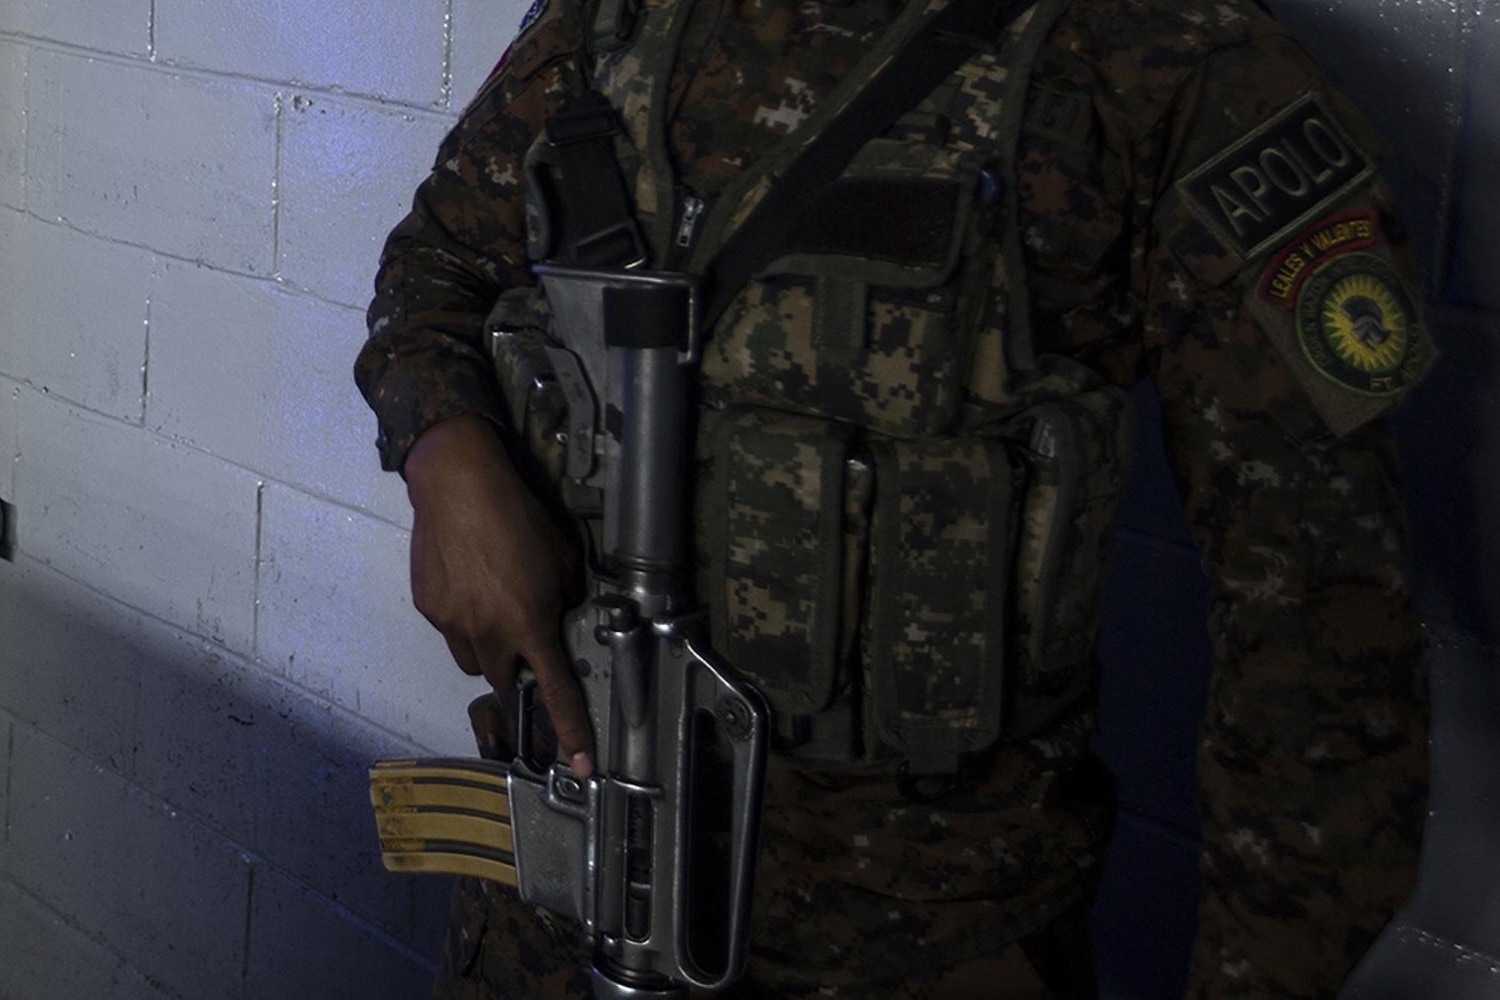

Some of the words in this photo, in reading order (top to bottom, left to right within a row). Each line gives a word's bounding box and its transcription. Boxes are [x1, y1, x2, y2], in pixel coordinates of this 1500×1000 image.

[1210, 117, 1350, 238] APOLO
[1267, 251, 1306, 299] LEALES
[1300, 242, 1316, 259] Y
